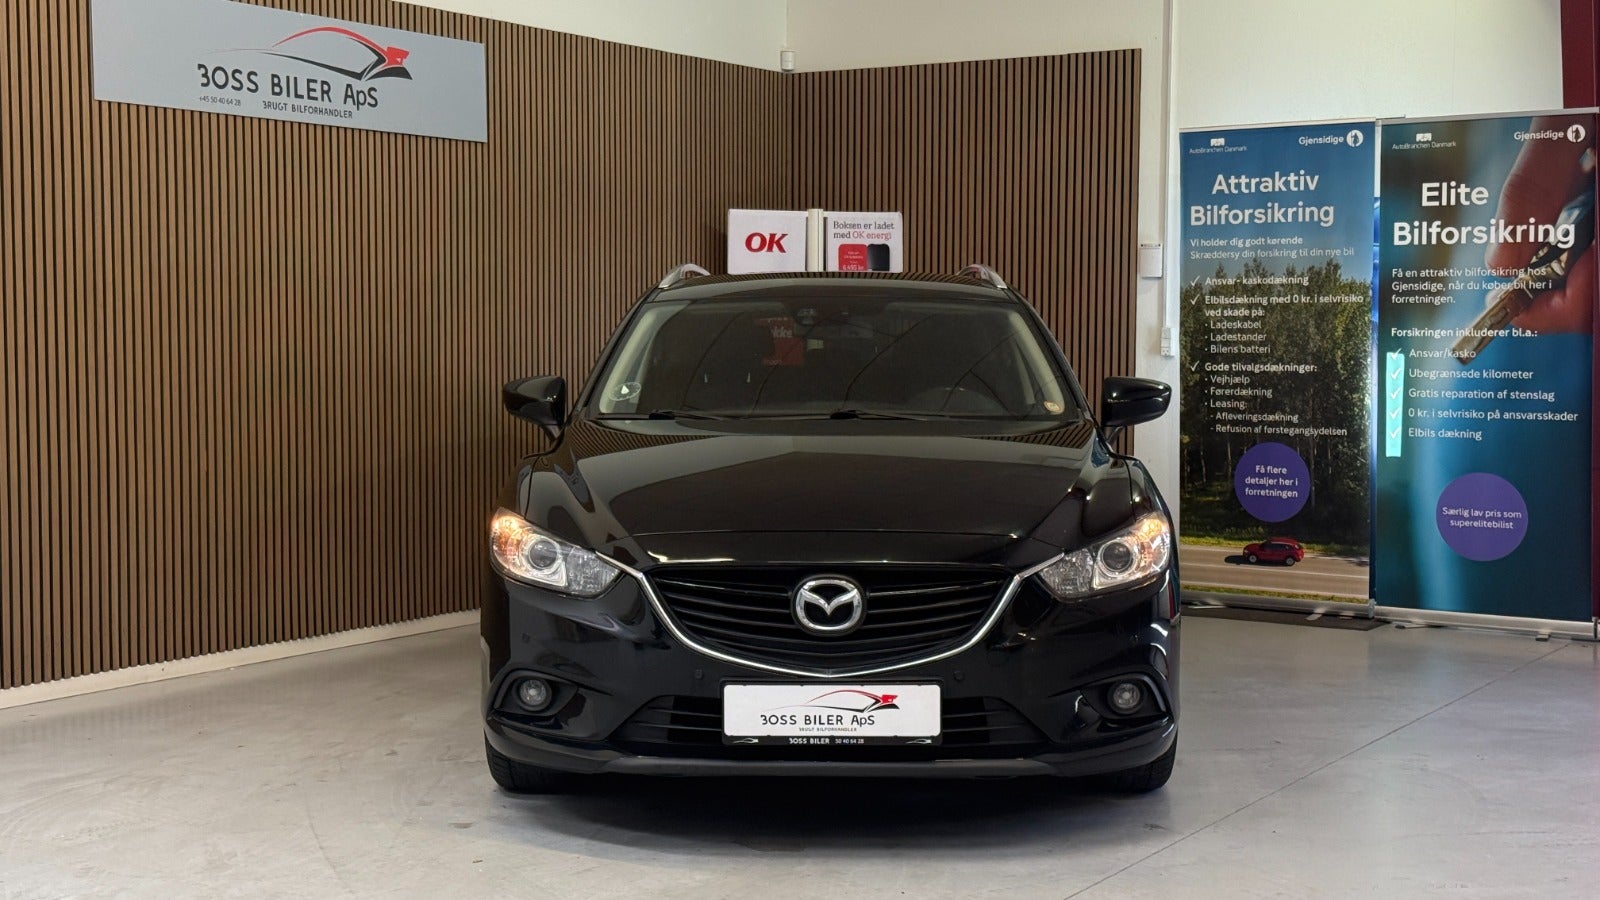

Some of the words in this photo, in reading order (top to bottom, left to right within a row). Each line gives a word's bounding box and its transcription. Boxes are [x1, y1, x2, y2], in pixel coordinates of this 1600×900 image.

[271, 74, 332, 102] BILER
[343, 84, 378, 110] ApS
[292, 104, 352, 118] BILFORHANDLER
[1298, 135, 1344, 146] Gjensidige
[1514, 129, 1564, 142] Gjensidige
[1392, 142, 1430, 150] AutoBranchen
[1431, 140, 1457, 148] Danmark
[1211, 170, 1319, 194] Attraktiv
[1422, 181, 1489, 207] Elite
[1190, 201, 1334, 227] Bilforsikring
[833, 221, 862, 230] Boksen
[874, 221, 894, 230] ladet
[833, 231, 850, 239] med
[852, 231, 865, 239] OK
[866, 231, 892, 240] energi
[1393, 217, 1575, 249] Bilforsikring
[745, 232, 788, 253] OK
[1190, 238, 1200, 247] Vi
[1201, 238, 1228, 246] holder
[1230, 237, 1244, 249] dig
[1245, 237, 1265, 248] godt
[1267, 236, 1303, 245] kørende
[1190, 250, 1240, 260] Skræddersy
[1242, 250, 1255, 258] din
[1257, 248, 1297, 258] forsikring
[1299, 248, 1308, 257] til
[1310, 248, 1323, 257] din
[1325, 250, 1341, 258] nye
[1343, 248, 1355, 256] bil
[1392, 268, 1403, 278] Få
[1420, 268, 1462, 277] attraktiv
[1465, 267, 1524, 278] bilforsikring
[1528, 267, 1546, 276] hos
[1205, 277, 1240, 286] Ansvar-
[1242, 276, 1309, 286] kaskodækning
[1391, 281, 1446, 292] Gjensidige,
[1448, 281, 1464, 290] når
[1466, 280, 1480, 289] du
[1482, 280, 1512, 289] køber
[1514, 280, 1526, 289] bil
[1528, 280, 1546, 289] her
[1549, 280, 1552, 289] i
[1205, 295, 1268, 306] Elbilsdækning
[1270, 295, 1291, 304] med
[1292, 295, 1299, 304] 0
[1301, 294, 1312, 303] kr.
[1314, 294, 1318, 303] i
[1319, 294, 1364, 303] selvrisiko
[1391, 294, 1456, 306] forretningen.
[1205, 308, 1221, 317] ved
[1223, 308, 1250, 317] skade
[1251, 308, 1265, 318] på:
[1210, 320, 1262, 329] Ladeskabel
[1210, 333, 1267, 342] Ladestander
[1391, 328, 1453, 339] Forsikringen
[1456, 328, 1510, 337] inkluderer
[1210, 345, 1238, 354] Bilens
[1240, 345, 1271, 353] batteri
[1409, 349, 1476, 359] Ansvar/kasko
[1205, 363, 1230, 372] Gode
[1232, 362, 1318, 373] tilvalgsdækninger:
[1210, 375, 1250, 385] Vejhjælp
[1409, 369, 1480, 380] Ubegrænsede
[1482, 370, 1533, 379] kilometer
[1210, 387, 1272, 398] Førerdækning
[1408, 388, 1439, 398] Gratis
[1441, 390, 1494, 401] reparation
[1497, 390, 1508, 399] af
[1510, 390, 1555, 402] stenslag
[1210, 400, 1248, 410] Leasing:
[1216, 412, 1298, 423] Afleveringsdækning
[1408, 408, 1414, 417] 0
[1417, 408, 1430, 417] kr.
[1432, 408, 1435, 417] i
[1437, 409, 1485, 419] selvrisiko
[1488, 410, 1500, 421] på
[1503, 410, 1578, 421] ansvarsskader
[1216, 425, 1252, 433] Refusion
[1254, 425, 1262, 433] af
[1264, 426, 1347, 437] førstegangsydelsen
[1408, 428, 1436, 438] Elbils
[1438, 429, 1482, 441] dækning
[1256, 465, 1265, 474] Få
[1267, 466, 1287, 474] flere
[1245, 476, 1277, 486] detaljer
[1280, 478, 1293, 486] her
[1296, 478, 1298, 486] i
[1245, 488, 1298, 499] forretningen
[1442, 507, 1469, 518] Særlig
[1471, 509, 1482, 517] lav
[1485, 509, 1501, 518] pris
[1450, 520, 1514, 529] superelitebilist
[804, 714, 843, 726] BILER
[850, 714, 875, 727] ApS
